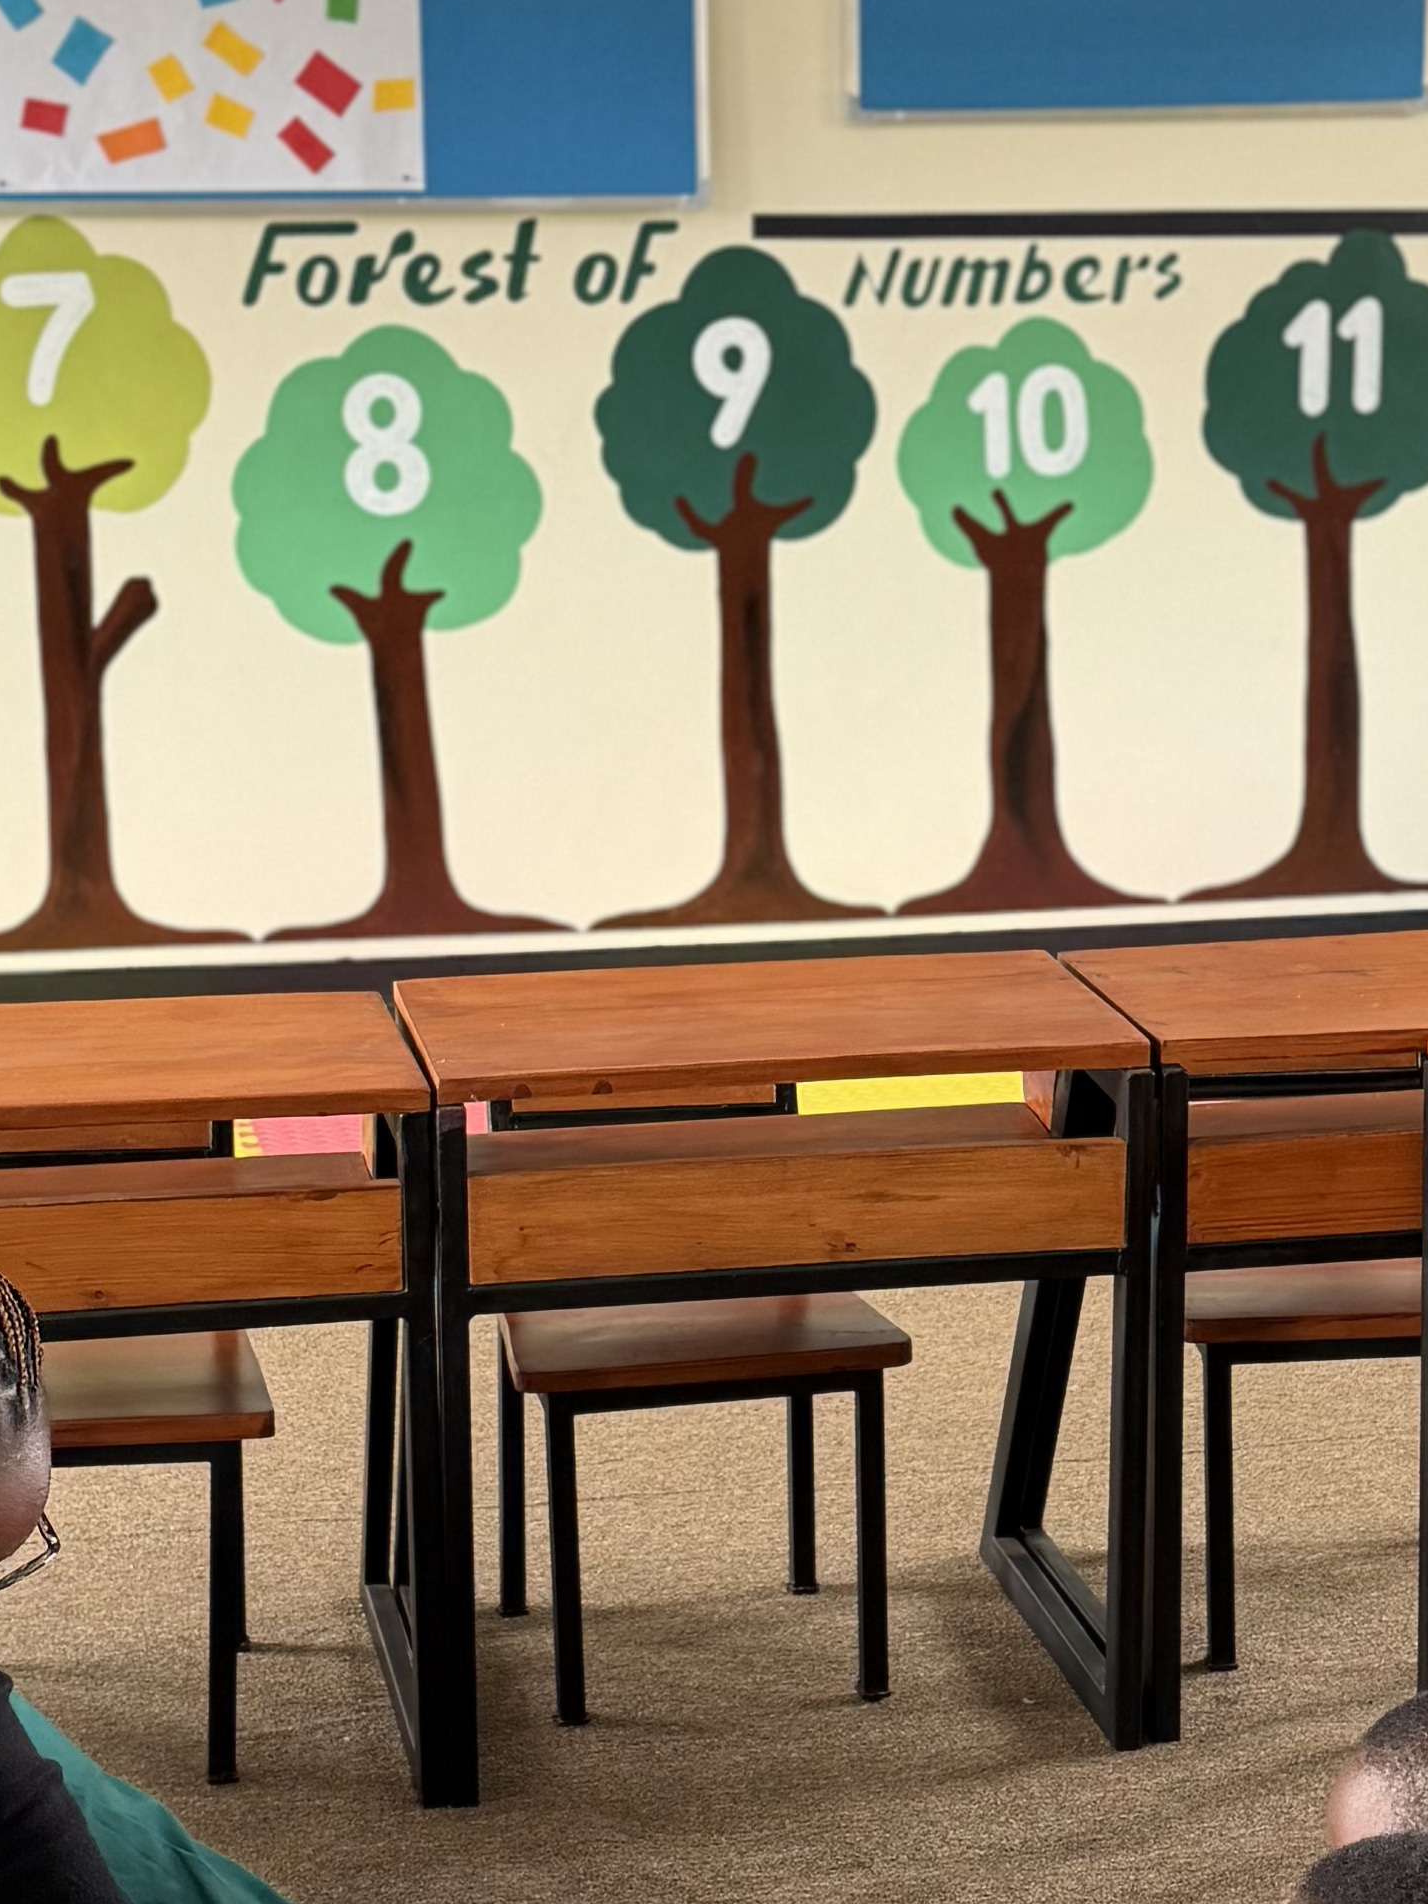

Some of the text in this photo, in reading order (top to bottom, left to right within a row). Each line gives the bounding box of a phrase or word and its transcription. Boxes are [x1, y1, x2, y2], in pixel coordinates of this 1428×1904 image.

[241, 217, 542, 307] Forest
[842, 243, 1182, 309] Numbers
[692, 317, 772, 449] 9
[1283, 297, 1382, 417] 11
[340, 370, 433, 518] 8
[967, 362, 1092, 482] 10
